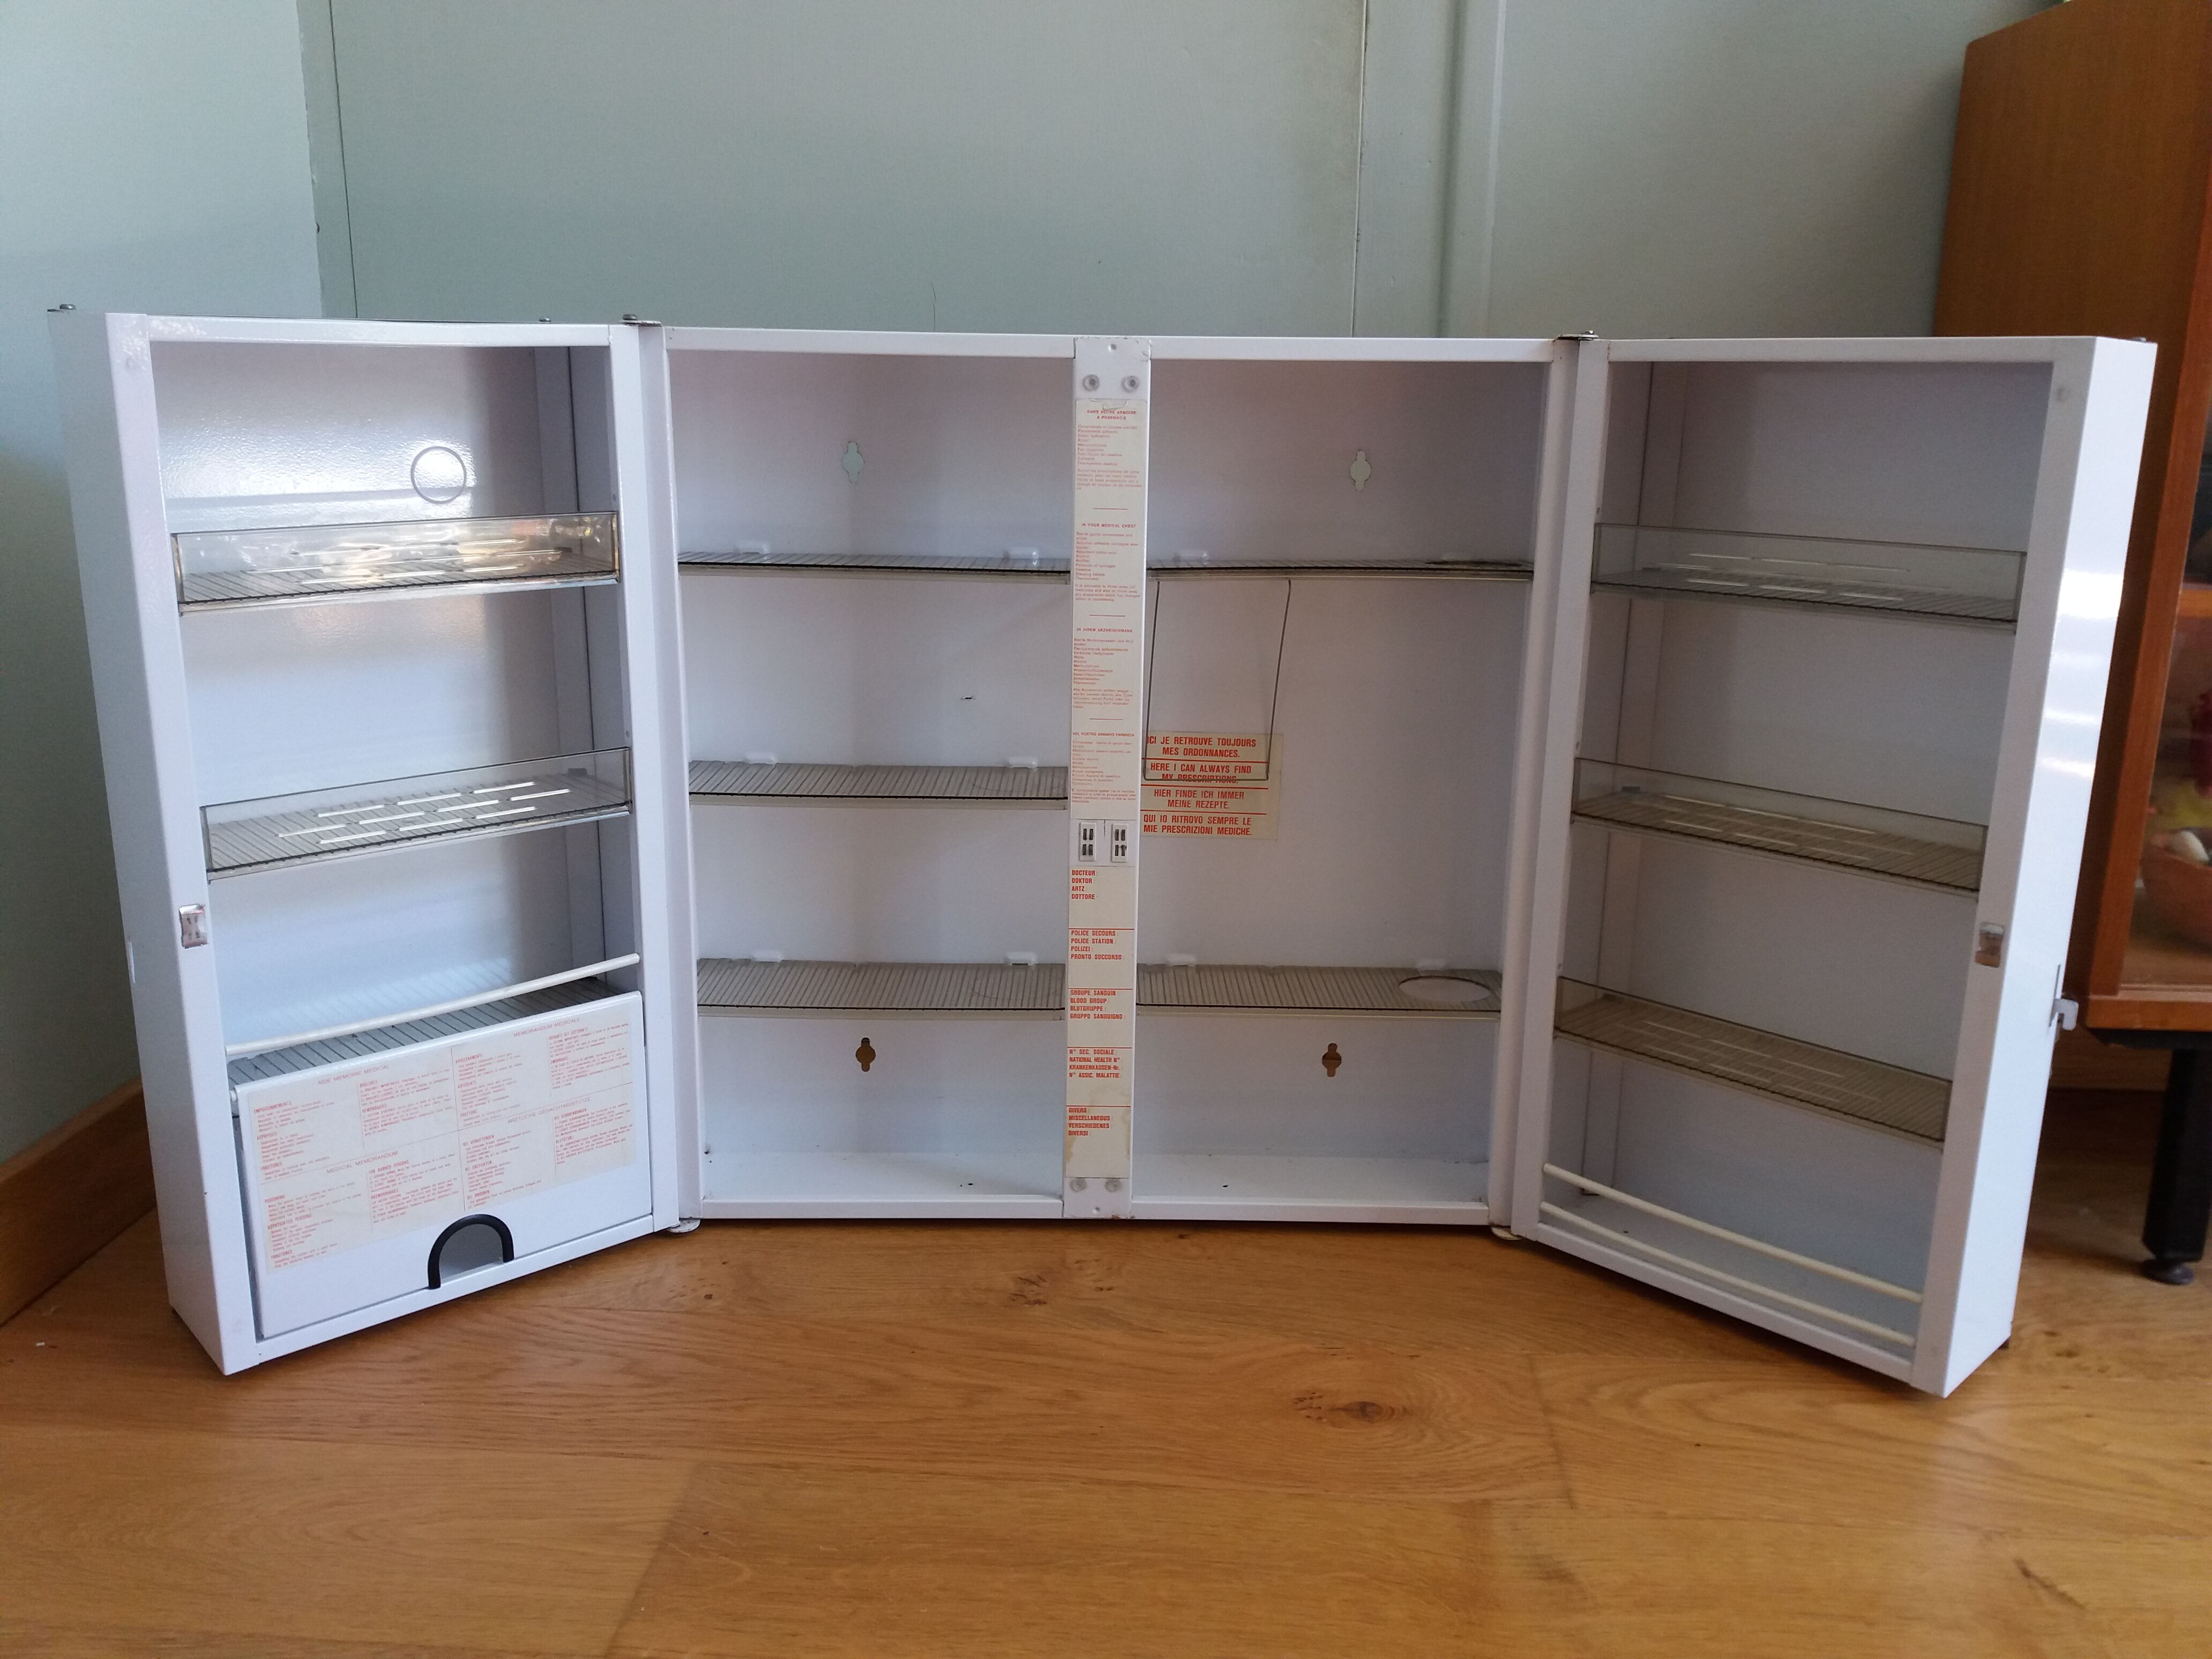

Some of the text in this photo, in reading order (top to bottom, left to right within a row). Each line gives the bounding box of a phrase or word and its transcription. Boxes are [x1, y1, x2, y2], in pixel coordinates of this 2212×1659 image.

[1147, 736, 1256, 748] ICI JE RETROUVE TOUJOURS
[1162, 747, 1240, 758] MES ORDONNANCES.
[1150, 763, 1170, 771] HERE
[1174, 763, 1176, 771] I
[1180, 764, 1195, 772] CAN
[1199, 764, 1230, 773] ALWAYS
[1162, 773, 1174, 781] MY
[1154, 789, 1244, 799] HIER FINDE ICH IMMER
[1168, 799, 1191, 808] MEINE
[1144, 814, 1156, 823] QUI
[1160, 814, 1167, 823] IO
[1171, 815, 1202, 824] RITROVO
[1207, 816, 1238, 825] SEMPRE
[1144, 824, 1252, 835] MIE PRESCRIZIONI MEDICHE.
[364, 1064, 389, 1074] MEDICAL
[327, 1163, 352, 1174] MEDICAL
[355, 1150, 398, 1165] MEMORANDUM
